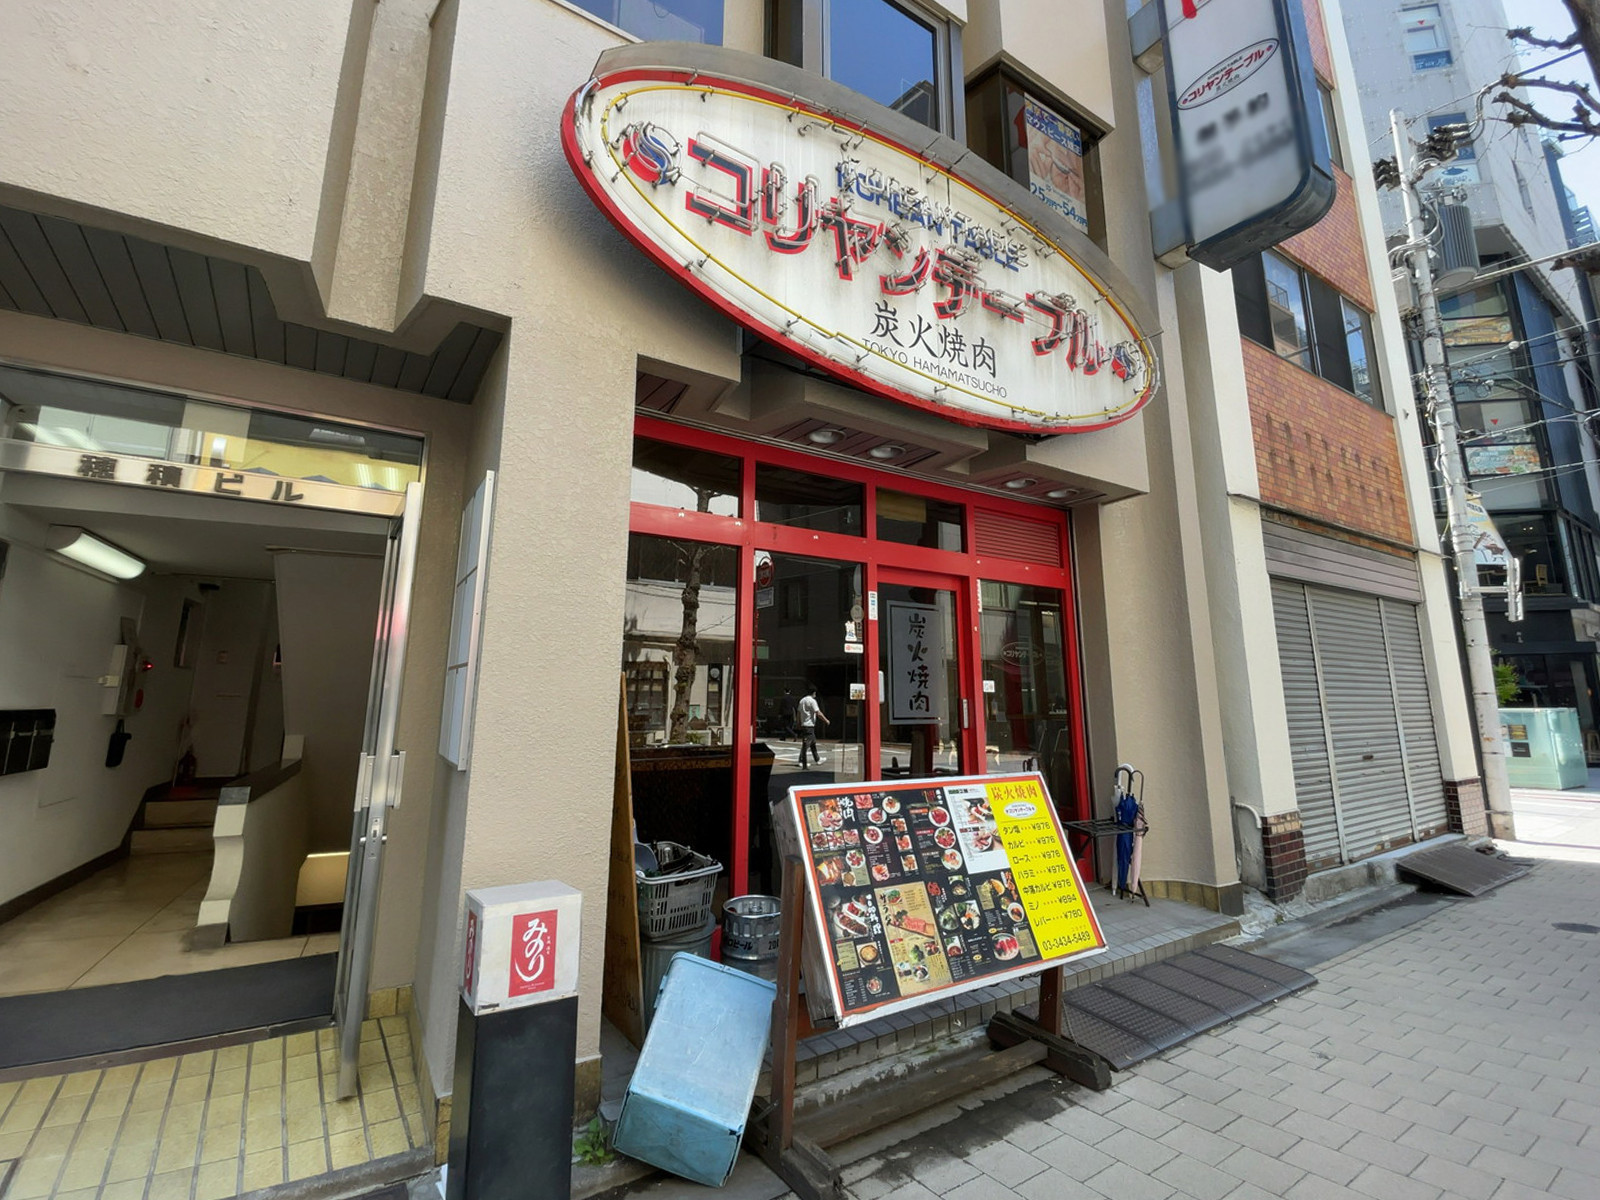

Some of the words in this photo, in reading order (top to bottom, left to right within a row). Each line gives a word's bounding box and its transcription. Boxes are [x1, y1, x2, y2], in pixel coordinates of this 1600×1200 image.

[861, 338, 908, 364] TOKYO
[913, 356, 1008, 398] HAMAMATSUCHO
[870, 299, 997, 379] 炭火焼肉
[907, 613, 930, 713] 炭火焼肉
[1012, 854, 1031, 864] ロース
